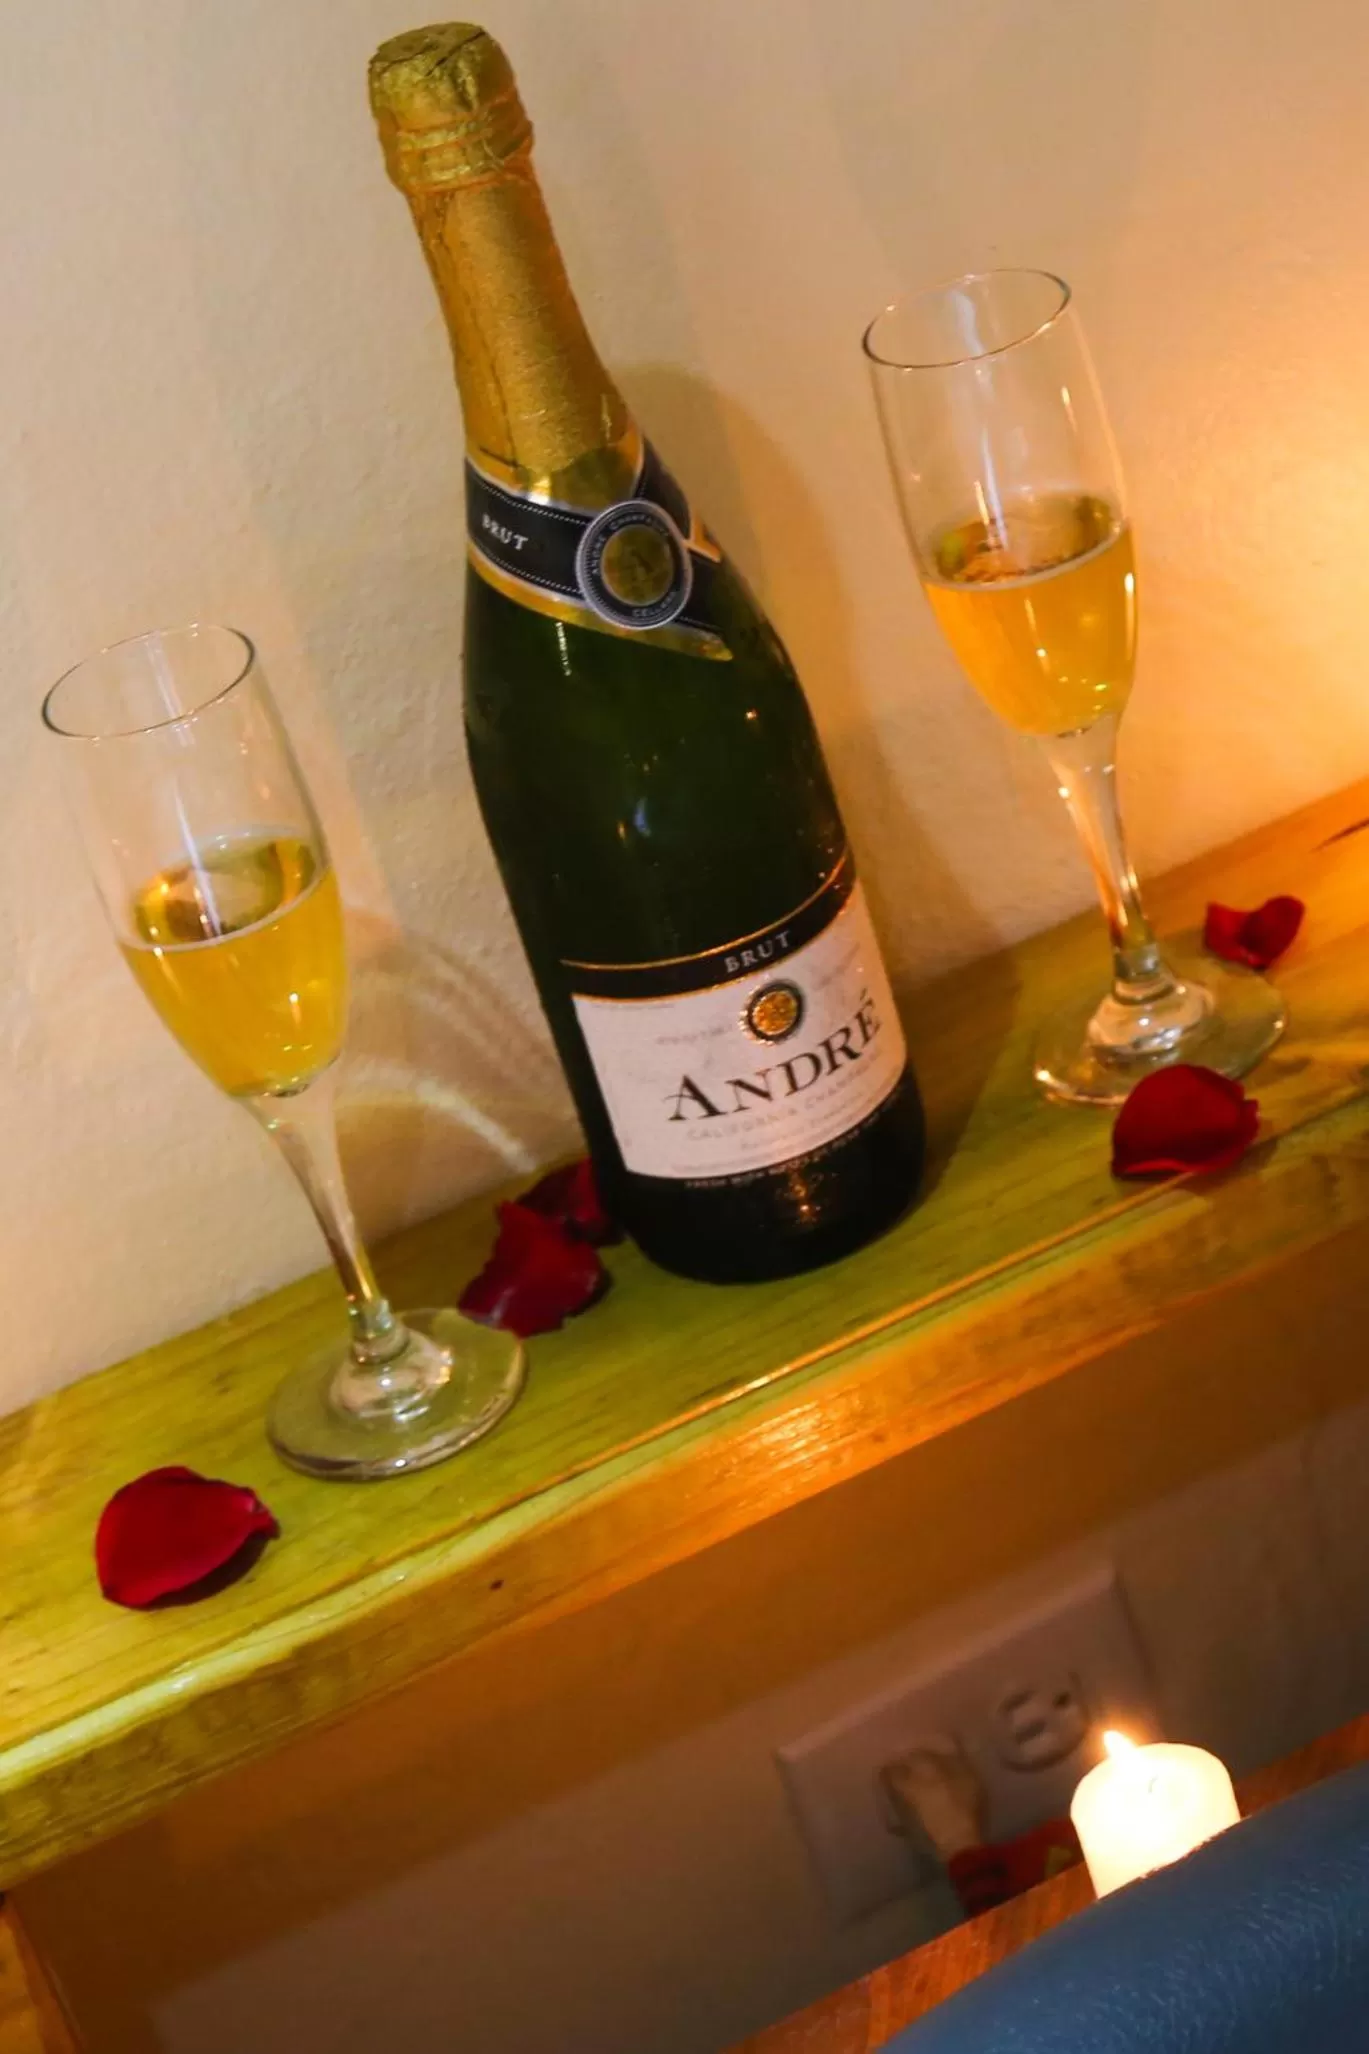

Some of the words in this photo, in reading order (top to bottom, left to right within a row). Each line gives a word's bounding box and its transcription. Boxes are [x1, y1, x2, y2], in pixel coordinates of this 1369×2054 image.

[481, 512, 530, 551] BRUT
[723, 930, 791, 974] BRUT
[662, 988, 882, 1122] ANDRÉ
